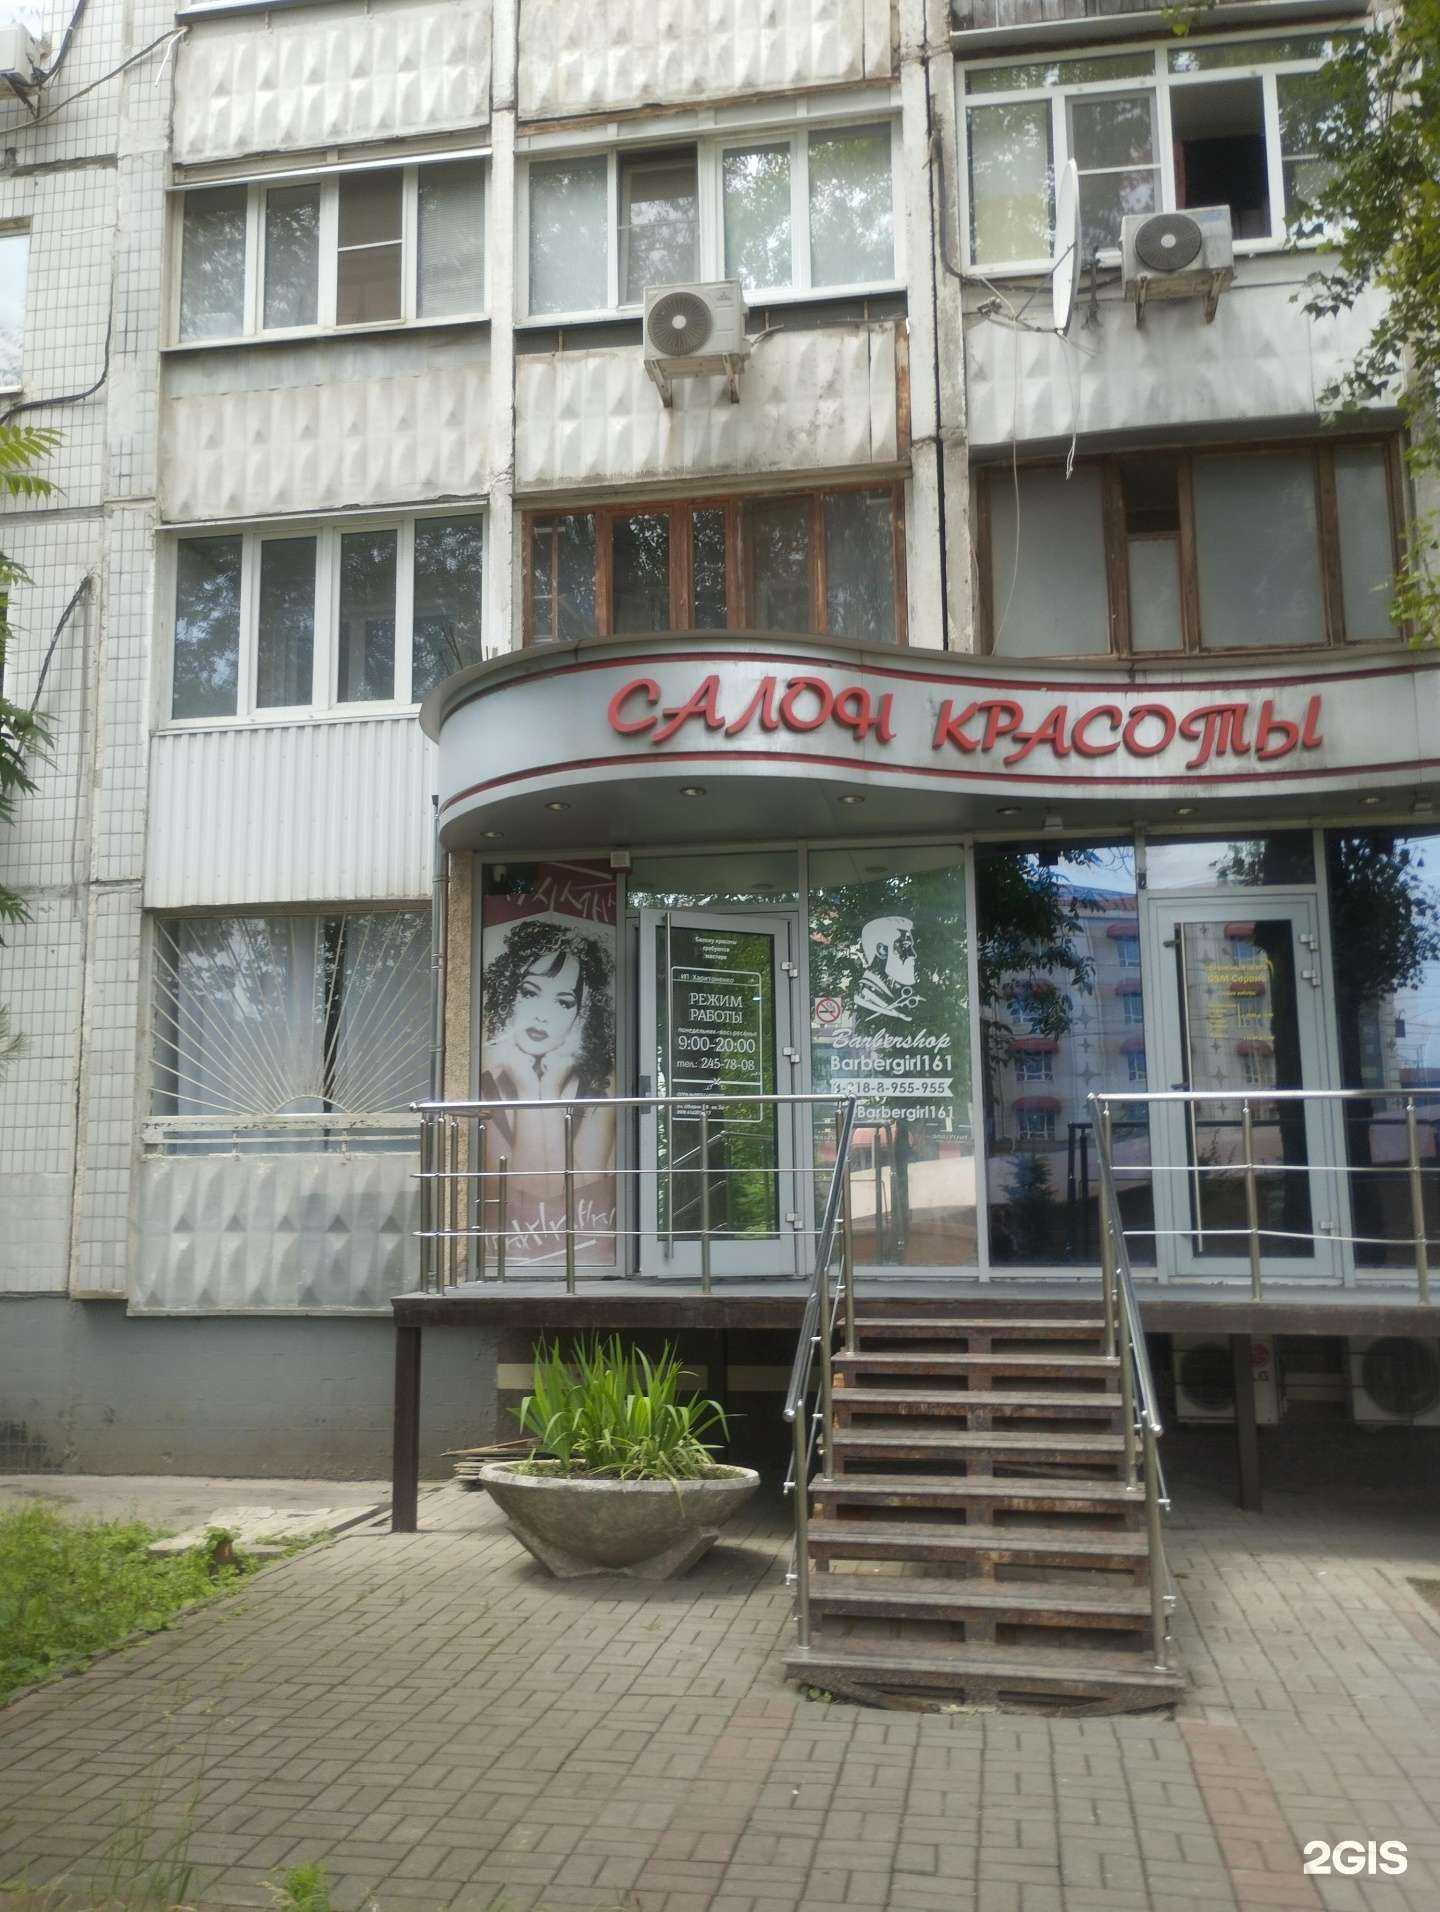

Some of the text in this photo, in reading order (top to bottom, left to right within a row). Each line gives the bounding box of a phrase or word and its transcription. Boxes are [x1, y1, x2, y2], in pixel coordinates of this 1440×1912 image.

[607, 674, 1322, 769] САЛОН КРАСОТЫ
[689, 992, 744, 1008] РЕЖИМ
[689, 1008, 743, 1024] РАБОТЫ
[678, 1035, 756, 1054] 9:00-20:00
[831, 1027, 951, 1053] Barbershop
[701, 1057, 755, 1071] 245-78-08
[830, 1054, 952, 1075] Barbergirl161
[857, 1104, 953, 1121] Barbergirl161
